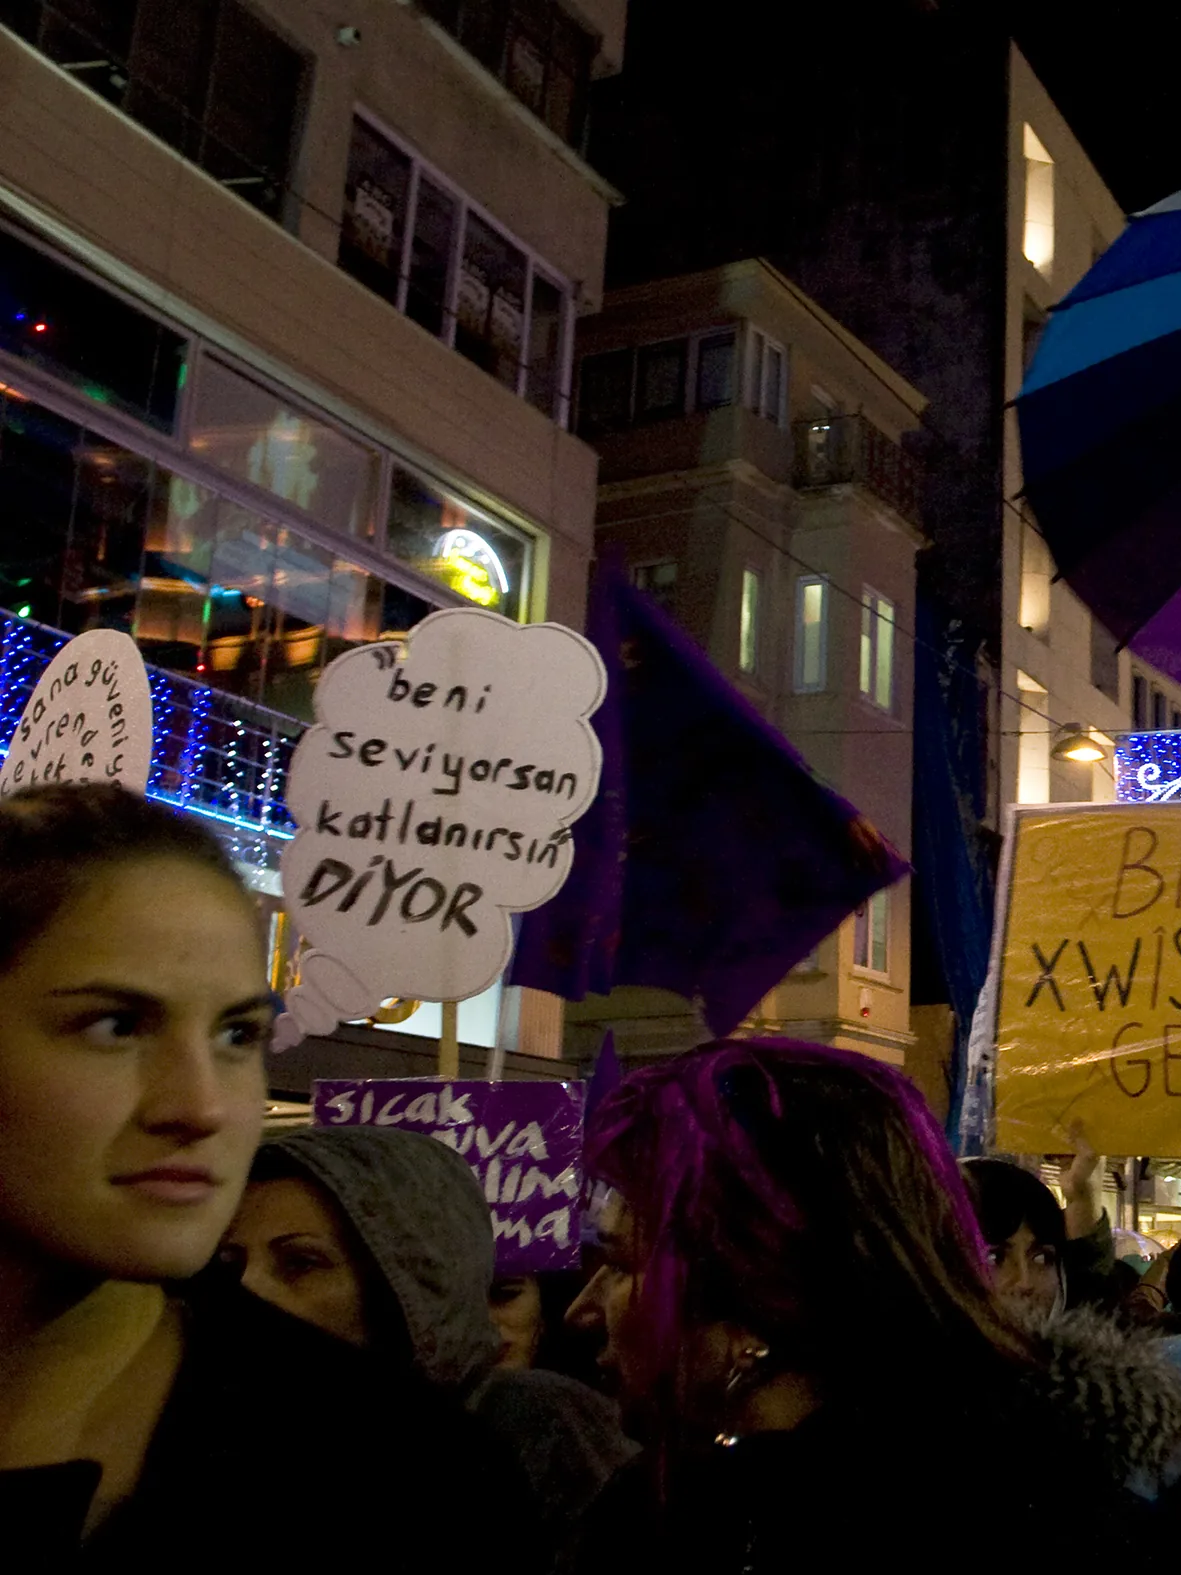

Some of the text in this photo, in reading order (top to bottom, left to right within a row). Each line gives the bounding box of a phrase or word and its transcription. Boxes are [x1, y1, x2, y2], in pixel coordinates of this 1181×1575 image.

[20, 661, 78, 743] sana
[328, 730, 577, 800] seviyorsan
[298, 854, 485, 938] DİYOR
[430, 1121, 549, 1160] uva
